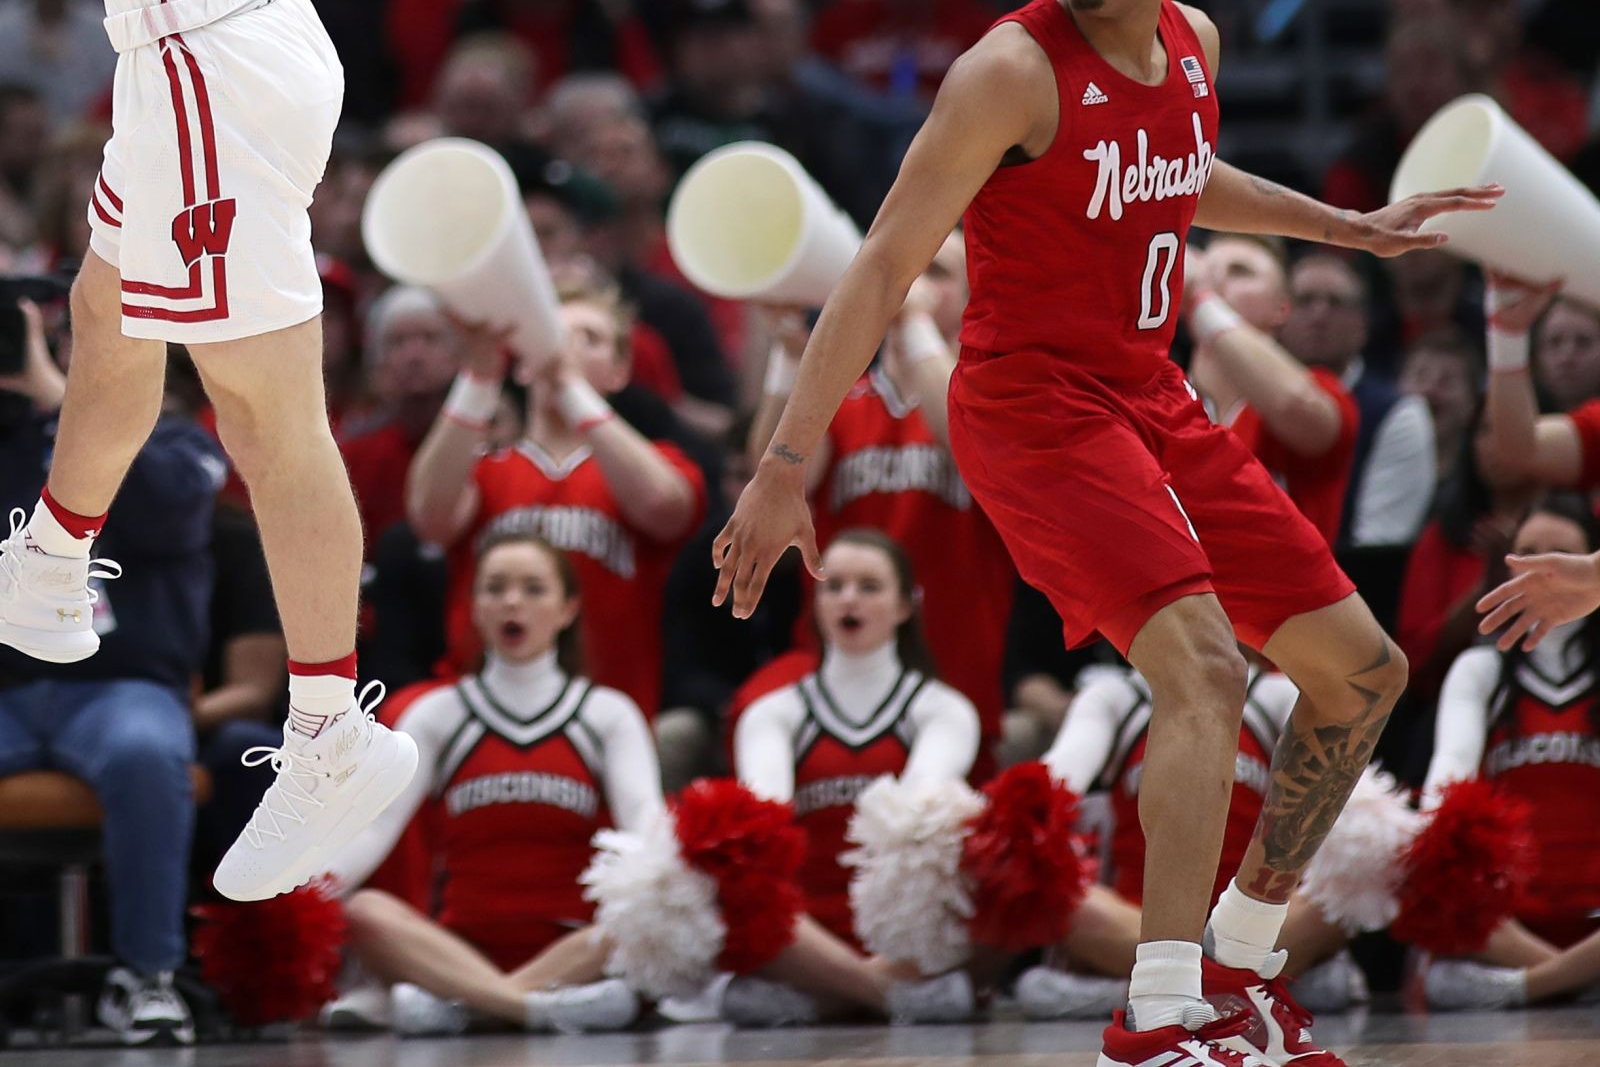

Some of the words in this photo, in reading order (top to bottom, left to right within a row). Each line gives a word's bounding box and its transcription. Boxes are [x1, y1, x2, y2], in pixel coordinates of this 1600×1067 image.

[1081, 94, 1109, 106] adidas
[1082, 111, 1215, 221] Nebrask
[171, 198, 236, 268] W
[1136, 232, 1180, 330] 0
